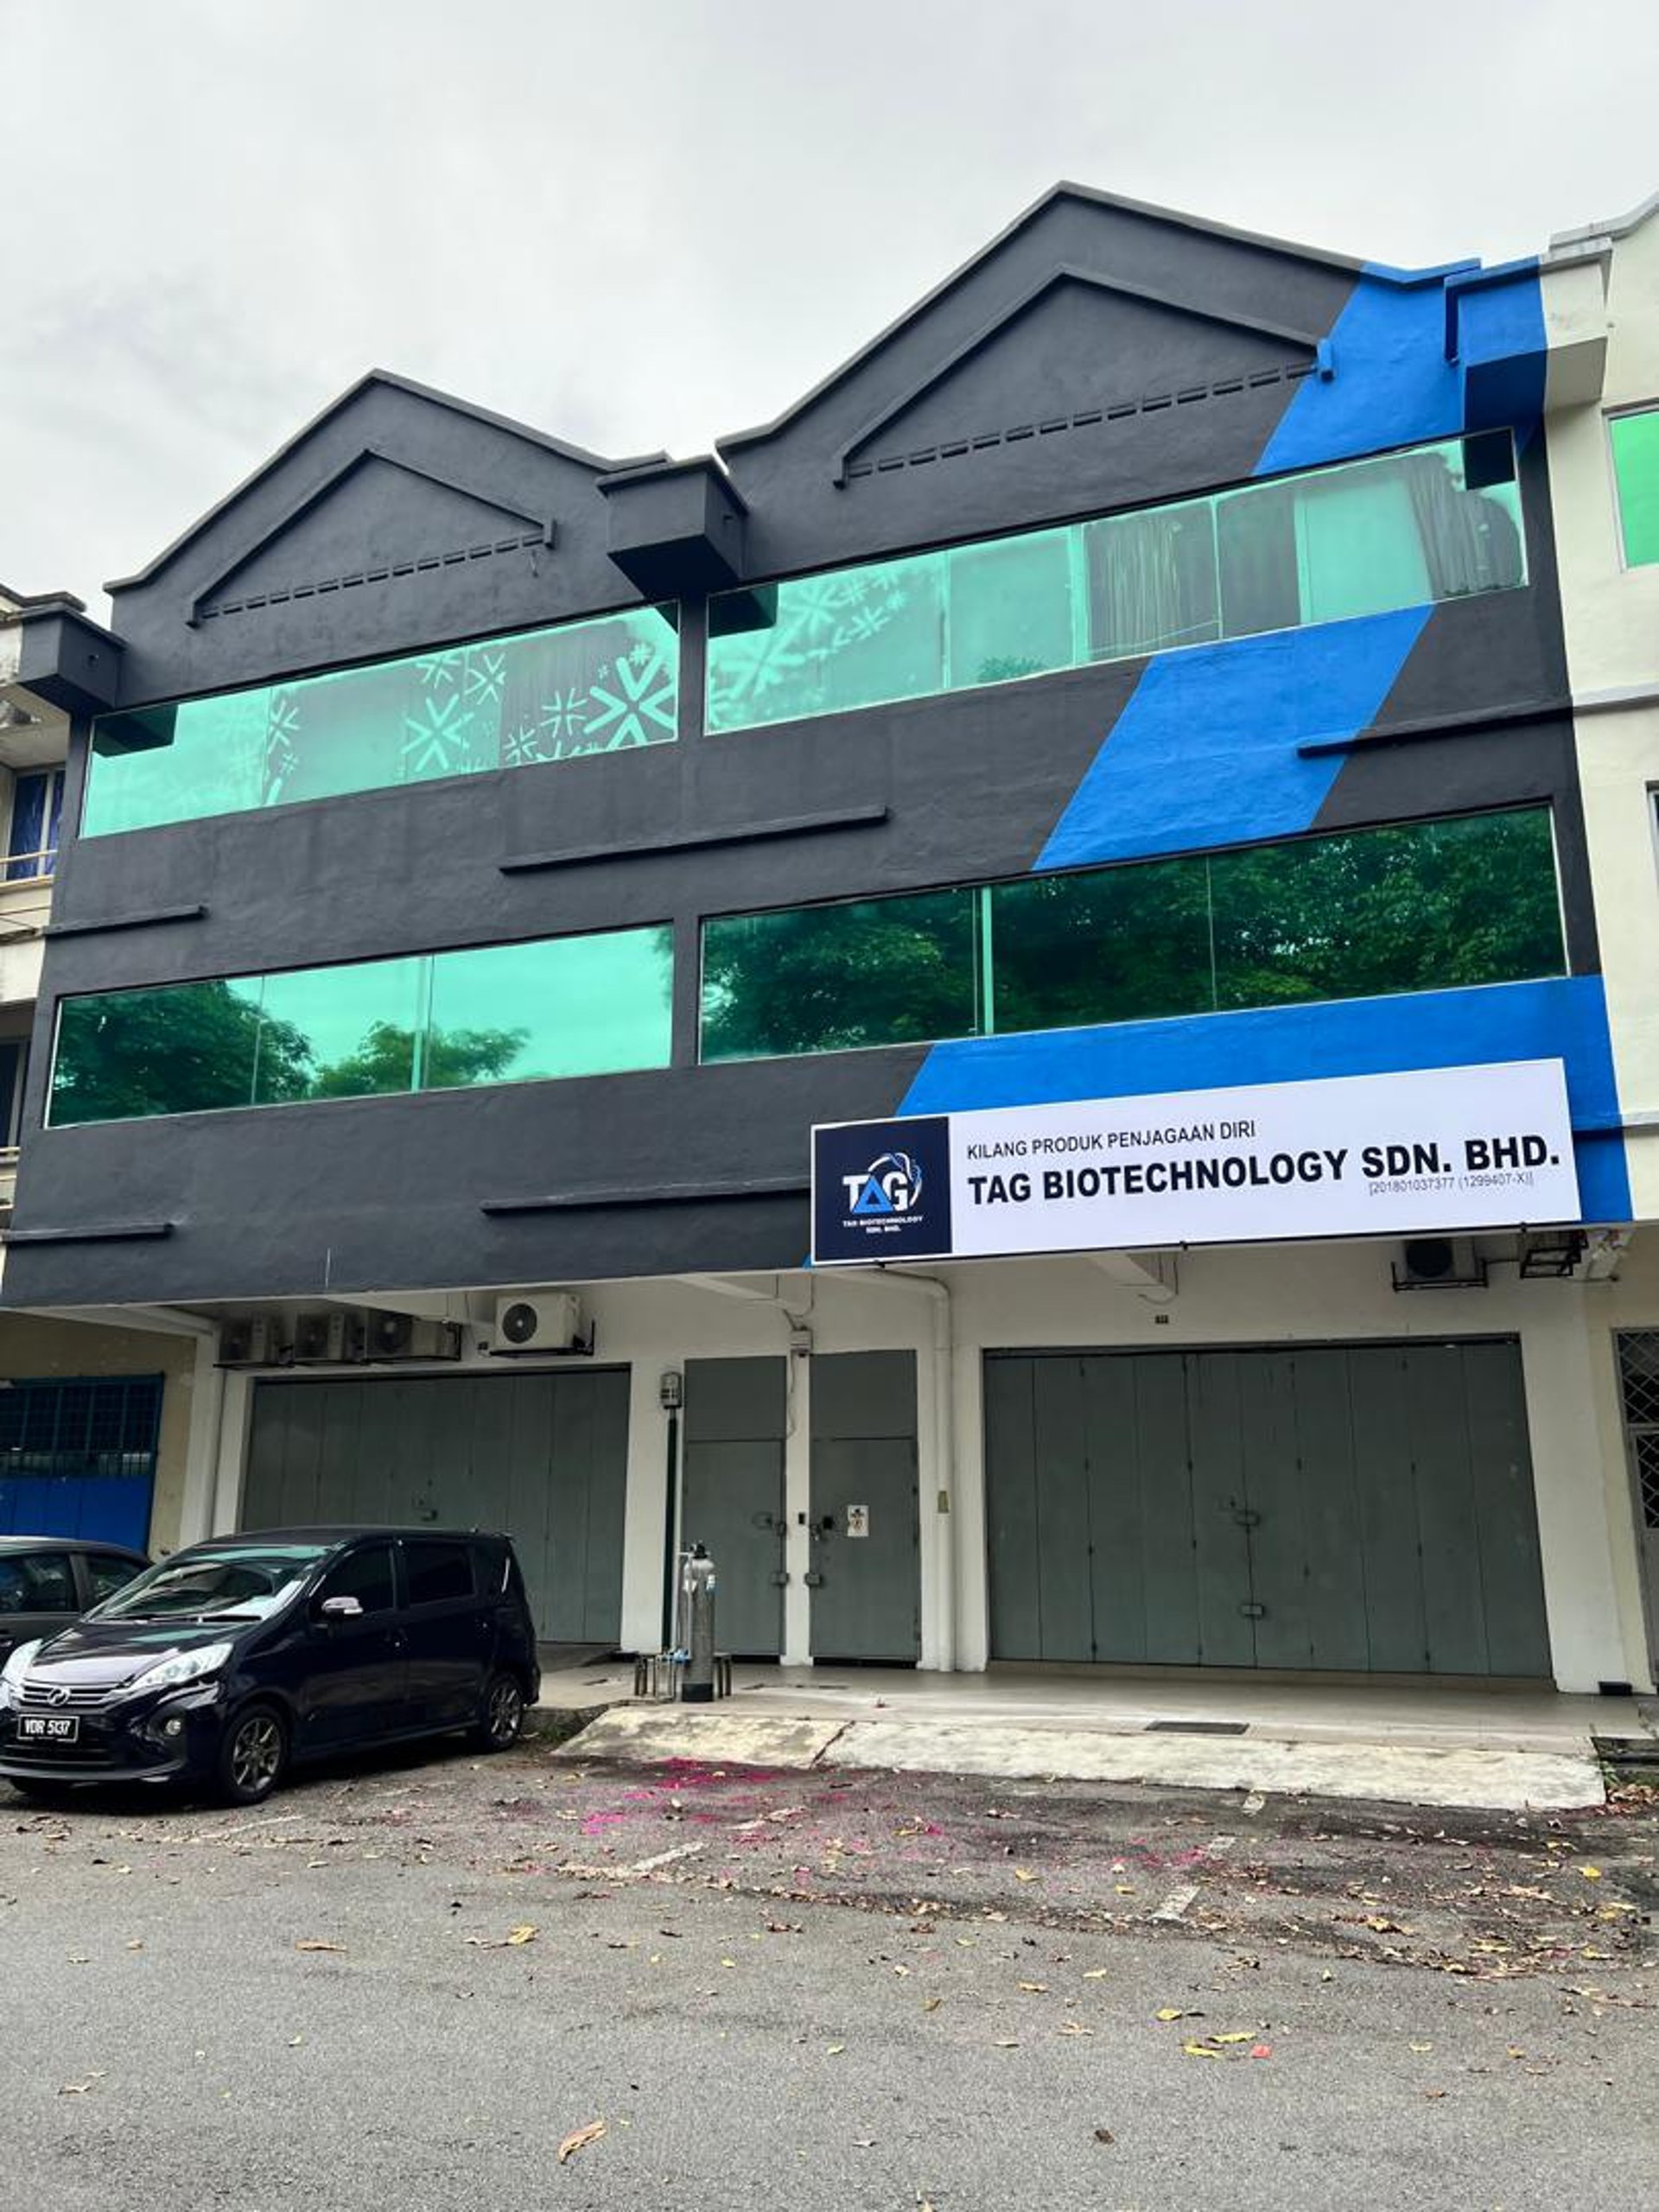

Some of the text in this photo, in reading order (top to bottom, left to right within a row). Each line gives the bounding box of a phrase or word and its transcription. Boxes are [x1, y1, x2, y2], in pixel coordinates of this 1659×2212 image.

[968, 1120, 1255, 1160] KILANG PRODUK PENJAGAAN DIRI
[968, 1135, 1560, 1205] TAG BIOTECHNOLOGY SDN. BHD.
[842, 1171, 908, 1214] TAG
